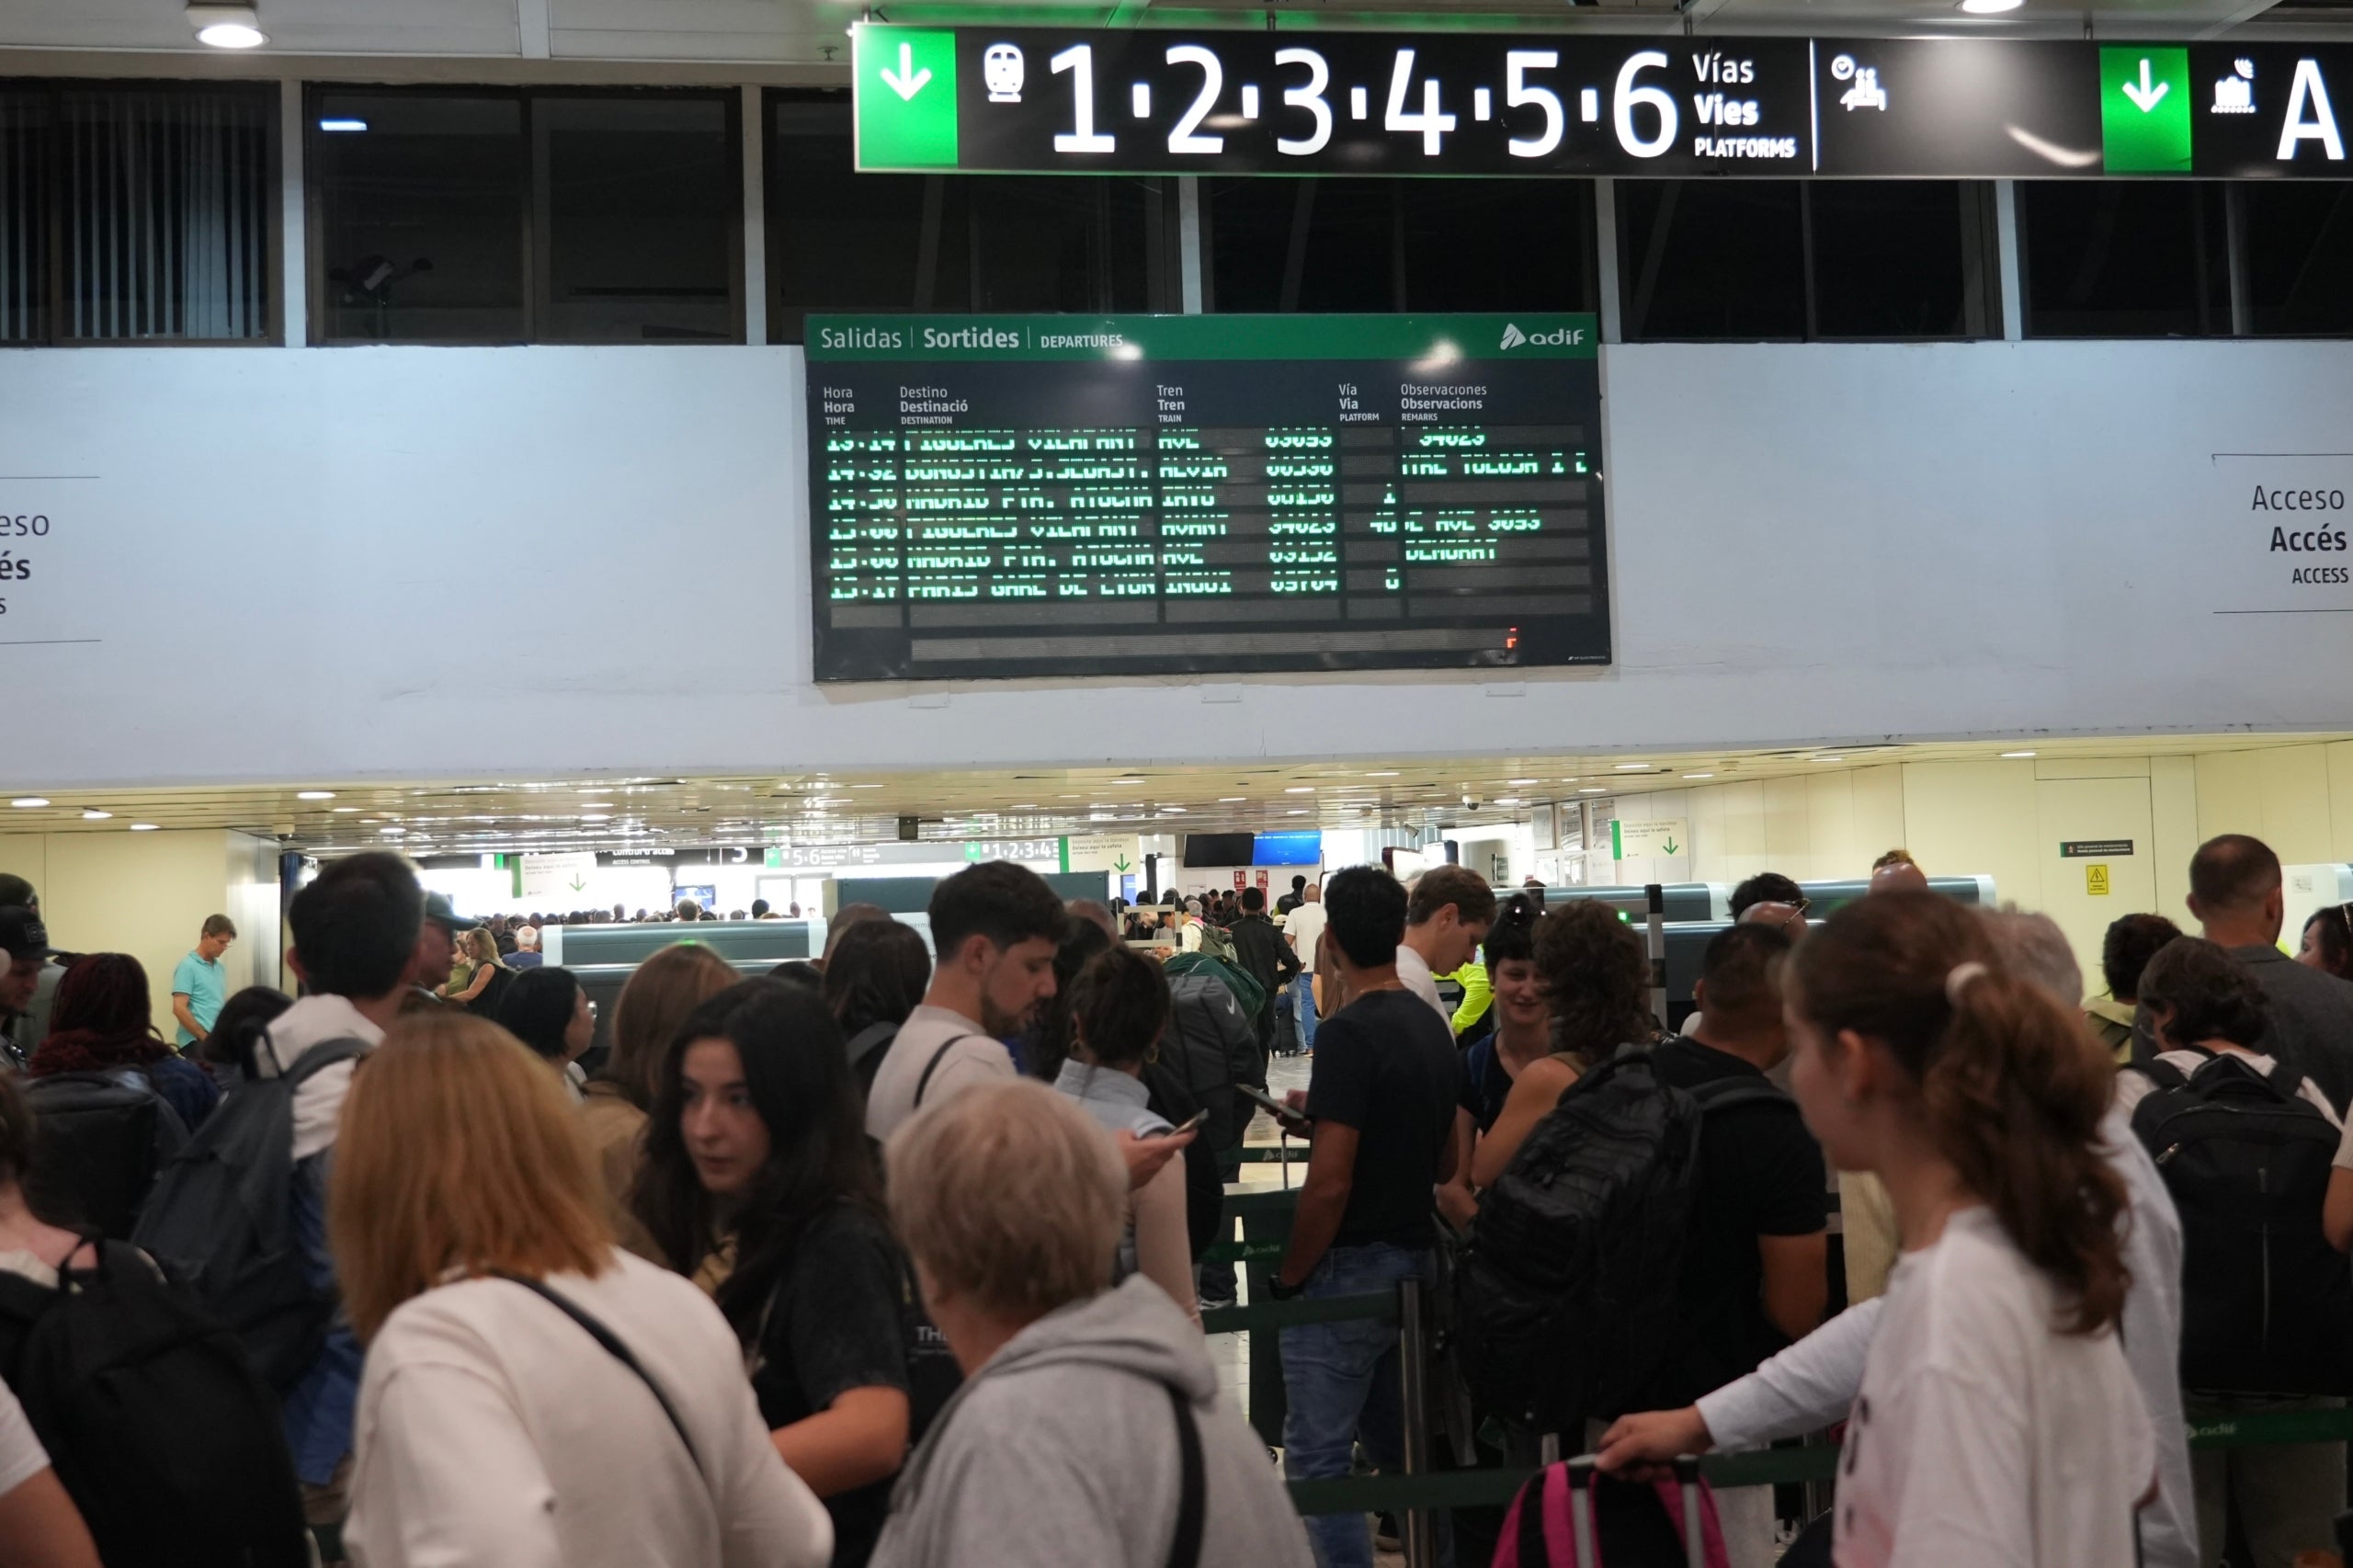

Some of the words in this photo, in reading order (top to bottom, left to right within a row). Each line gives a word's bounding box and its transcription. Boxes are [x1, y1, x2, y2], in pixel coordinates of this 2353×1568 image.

[1692, 52, 1754, 84] Vías
[1694, 94, 1759, 126] Vies
[2276, 59, 2345, 160] A
[1694, 137, 1796, 159] PLATFORMS
[821, 327, 902, 349] Salidas
[924, 327, 1020, 349] Sortides
[1040, 334, 1123, 348] DEPARTURES
[1529, 328, 1586, 347] adif
[824, 386, 853, 399] Hora
[900, 386, 948, 399] Destino
[1157, 384, 1183, 397] Tren
[1338, 383, 1358, 396] Vía
[1401, 383, 1487, 396] Observaciones
[824, 401, 855, 413] Hora
[900, 399, 969, 413] Destinació
[1157, 399, 1186, 411] Tren
[1339, 398, 1359, 410] Via
[1401, 398, 1483, 410] Observacions
[825, 416, 847, 426] TIME
[901, 415, 953, 426] DESTINATION
[1158, 415, 1182, 424] TRAIN
[1339, 413, 1380, 422] PLATFORM
[1401, 413, 1438, 422] REMARKS
[2252, 485, 2345, 511] Acceso
[2270, 523, 2347, 552] Accés
[2292, 567, 2349, 585] ACCESS
[2200, 1422, 2237, 1435] adif
